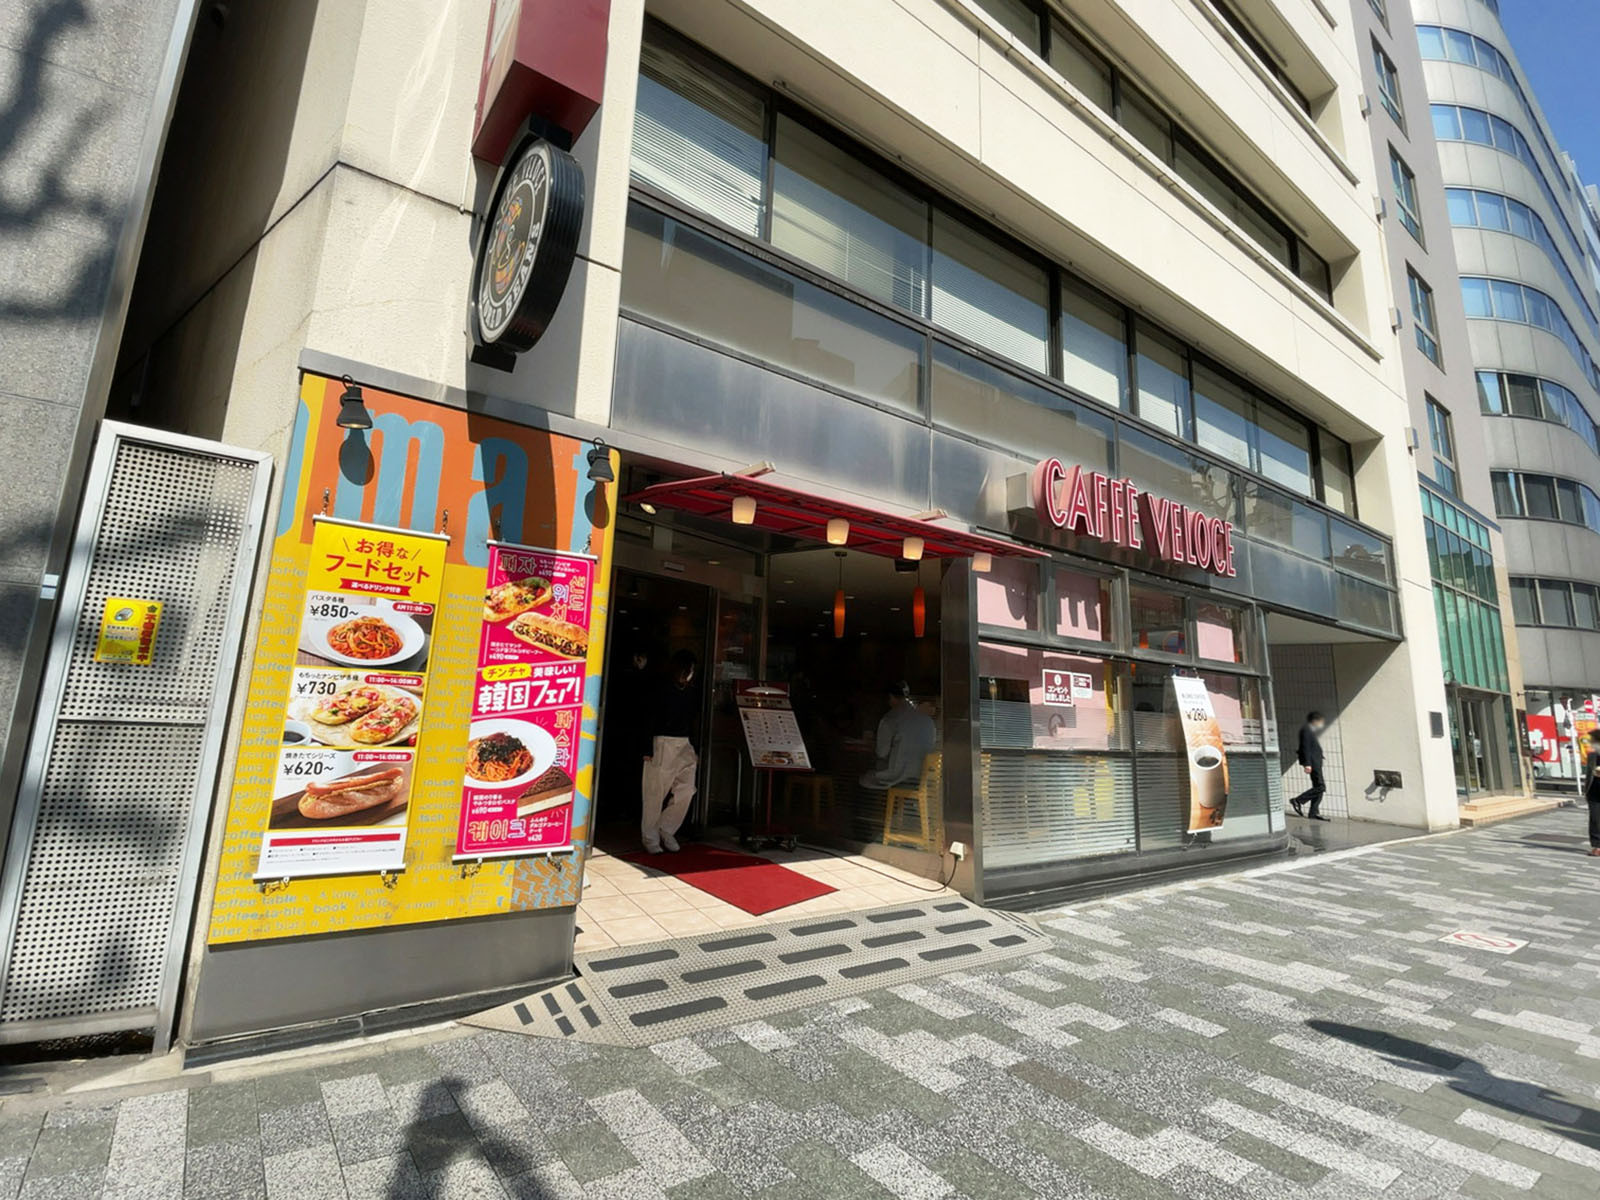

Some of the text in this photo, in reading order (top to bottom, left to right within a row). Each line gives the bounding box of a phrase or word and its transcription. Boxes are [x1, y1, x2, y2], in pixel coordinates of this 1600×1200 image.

[505, 222, 540, 318] BEANS
[1034, 456, 1236, 577] CAFFÈ VELOCE
[355, 538, 409, 560] お得な
[325, 554, 431, 584] フードセット
[487, 666, 526, 678] チンチャ
[296, 681, 337, 695] ¥730
[478, 677, 580, 714] 韓国フェア!
[285, 752, 336, 761] 焼きたてシリーズ
